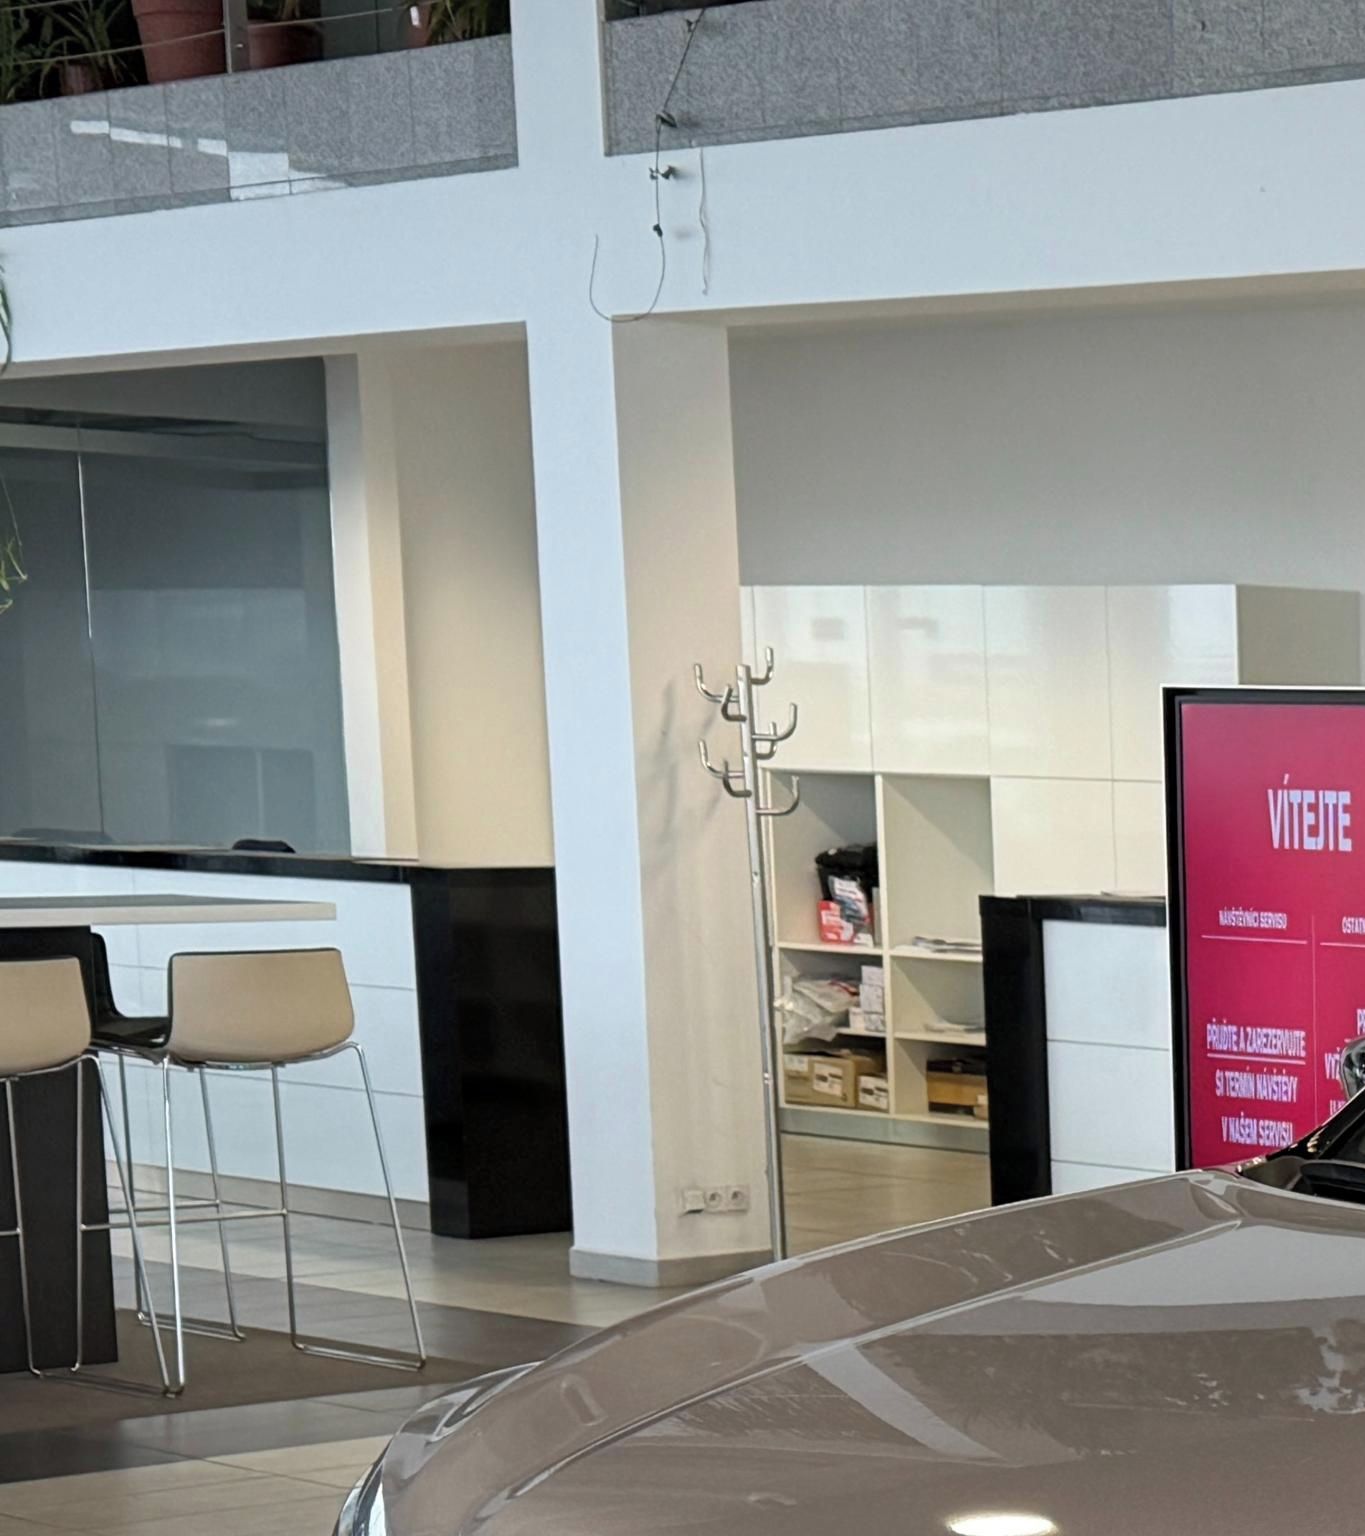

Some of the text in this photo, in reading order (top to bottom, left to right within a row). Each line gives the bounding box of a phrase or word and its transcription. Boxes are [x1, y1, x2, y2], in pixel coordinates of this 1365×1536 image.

[1267, 773, 1353, 852] VÍTEJTE
[1239, 1026, 1246, 1052] A
[1215, 1069, 1224, 1097] SI
[1225, 1066, 1255, 1099] TERMÍN
[1221, 1116, 1228, 1142] V
[1228, 1111, 1258, 1145] NAŠEM
